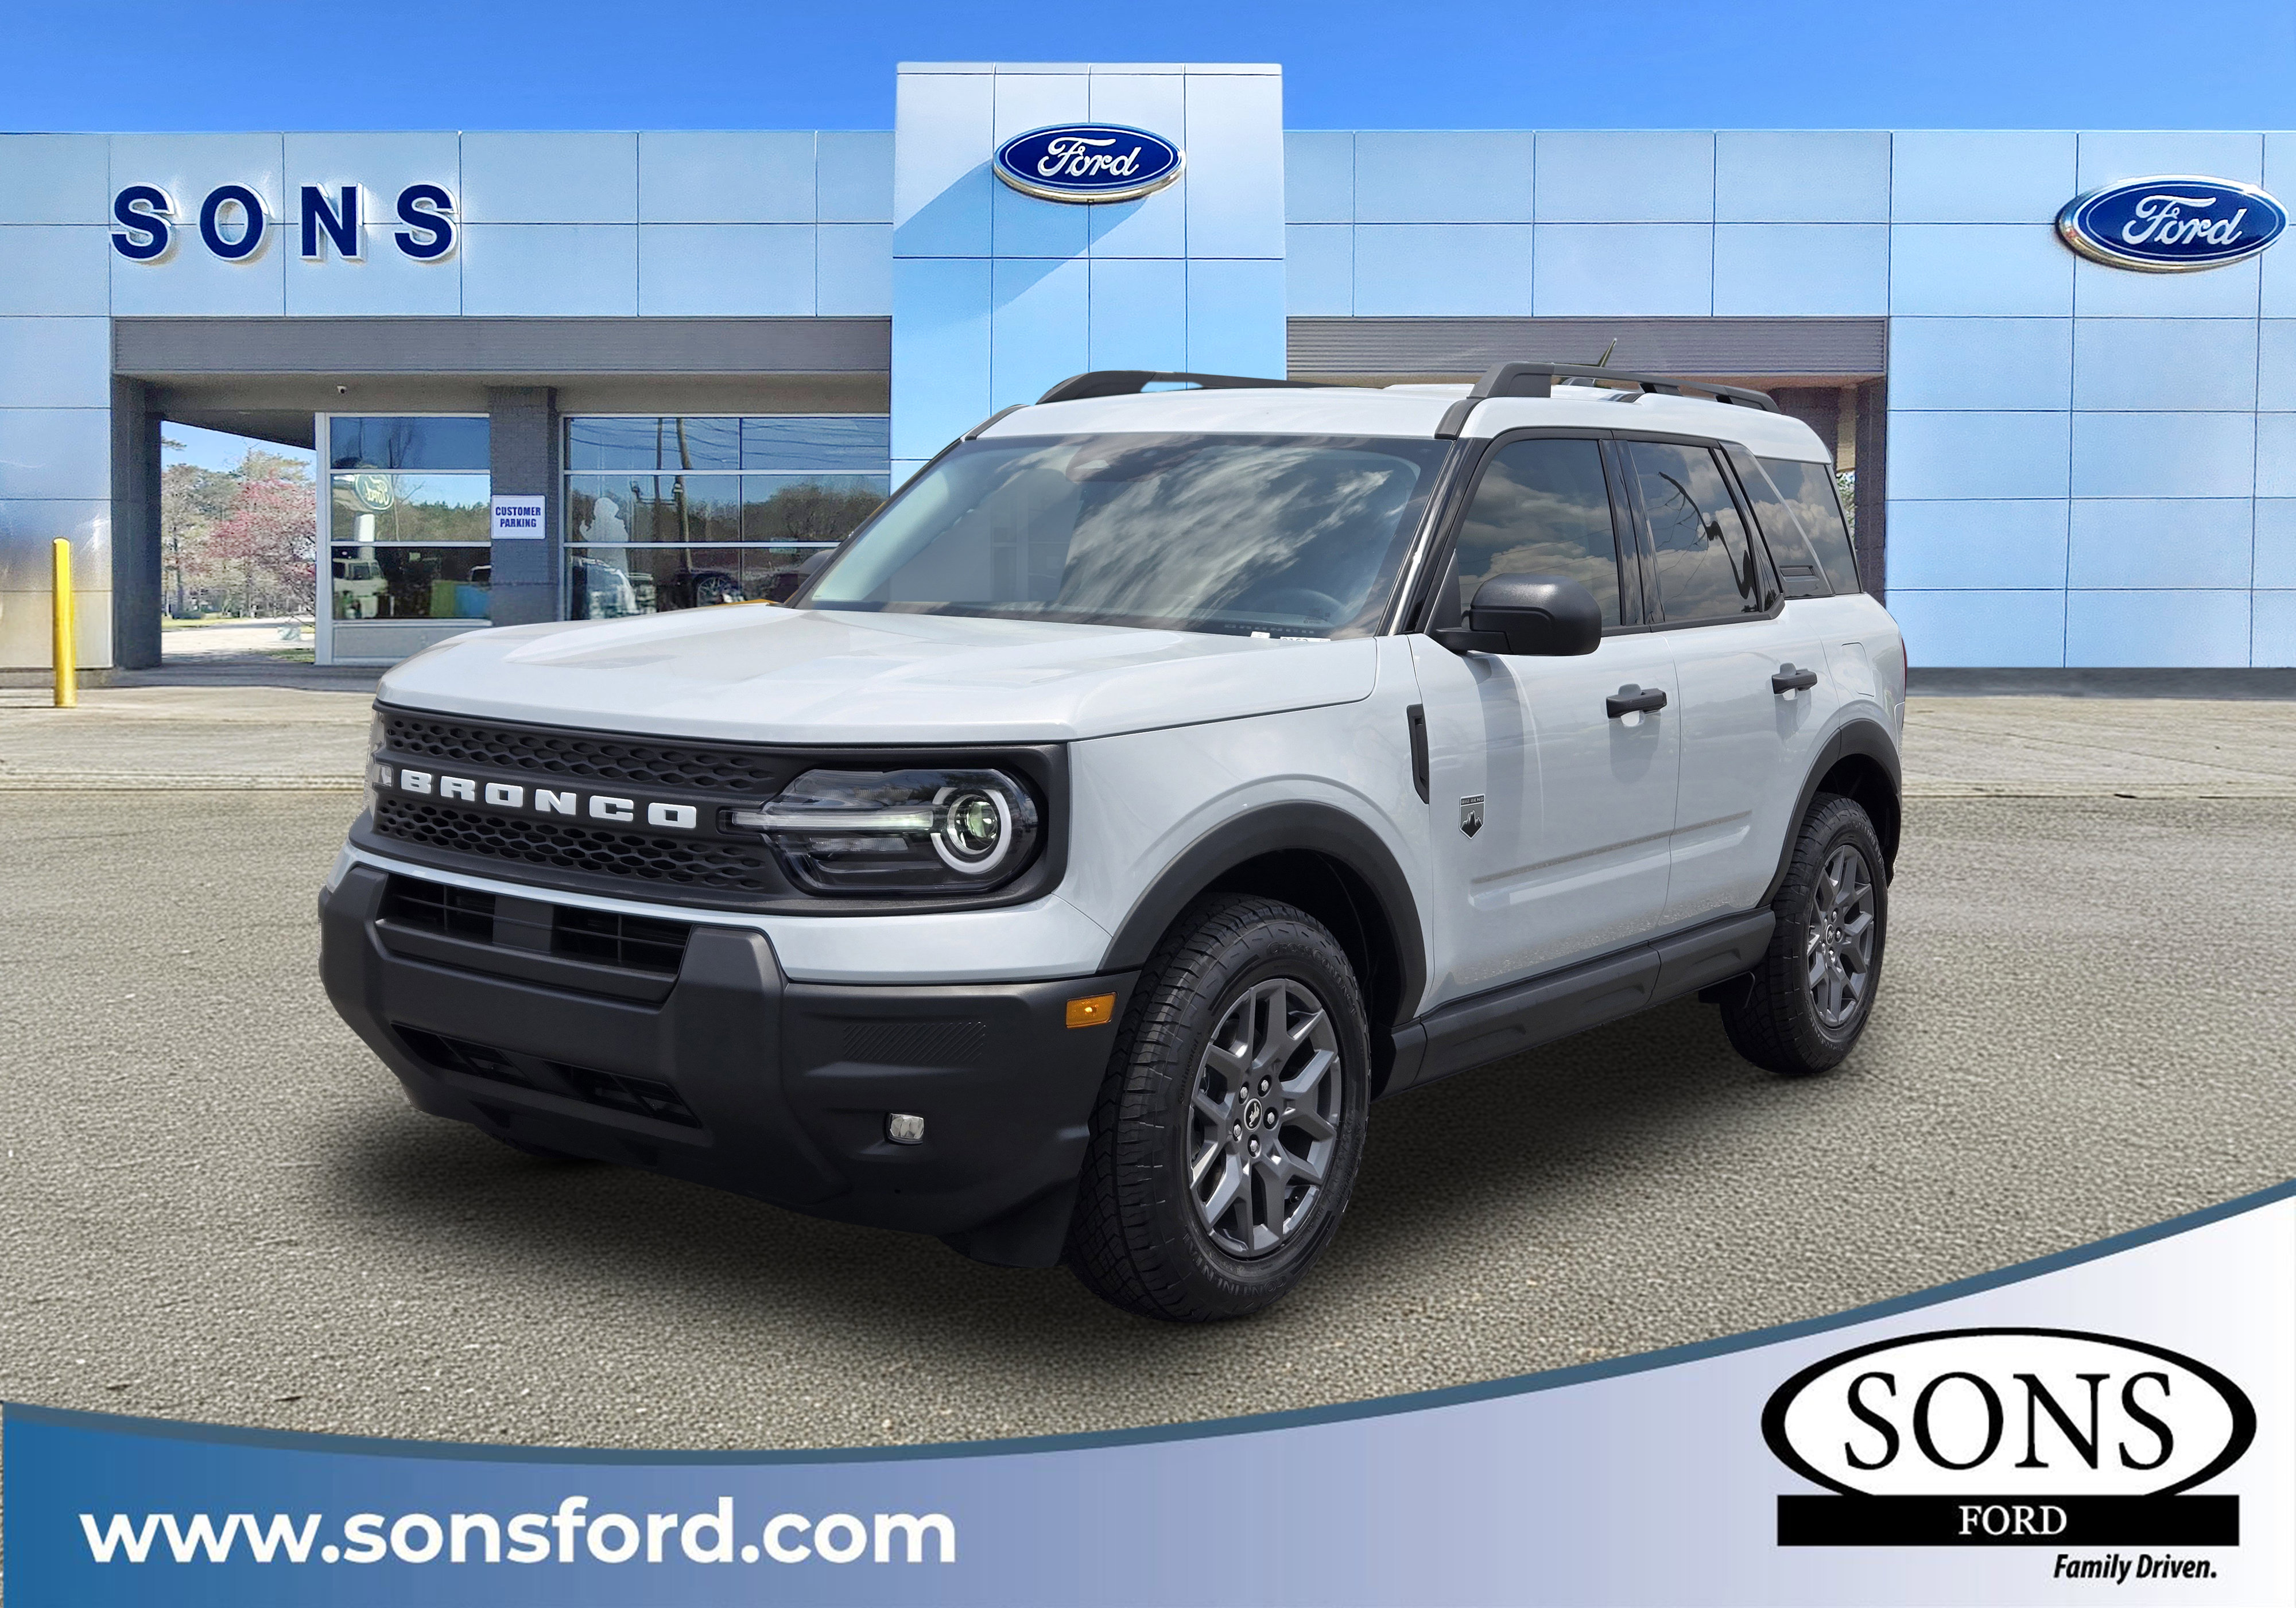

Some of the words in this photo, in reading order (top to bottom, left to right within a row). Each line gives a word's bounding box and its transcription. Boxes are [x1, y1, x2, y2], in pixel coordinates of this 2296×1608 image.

[1037, 136, 1142, 177] Ford
[111, 182, 458, 261] SONS
[2122, 195, 2247, 245] Ford
[495, 507, 541, 516] CUSTOMER
[500, 519, 537, 527] PARKING
[400, 768, 697, 829] BRONCO
